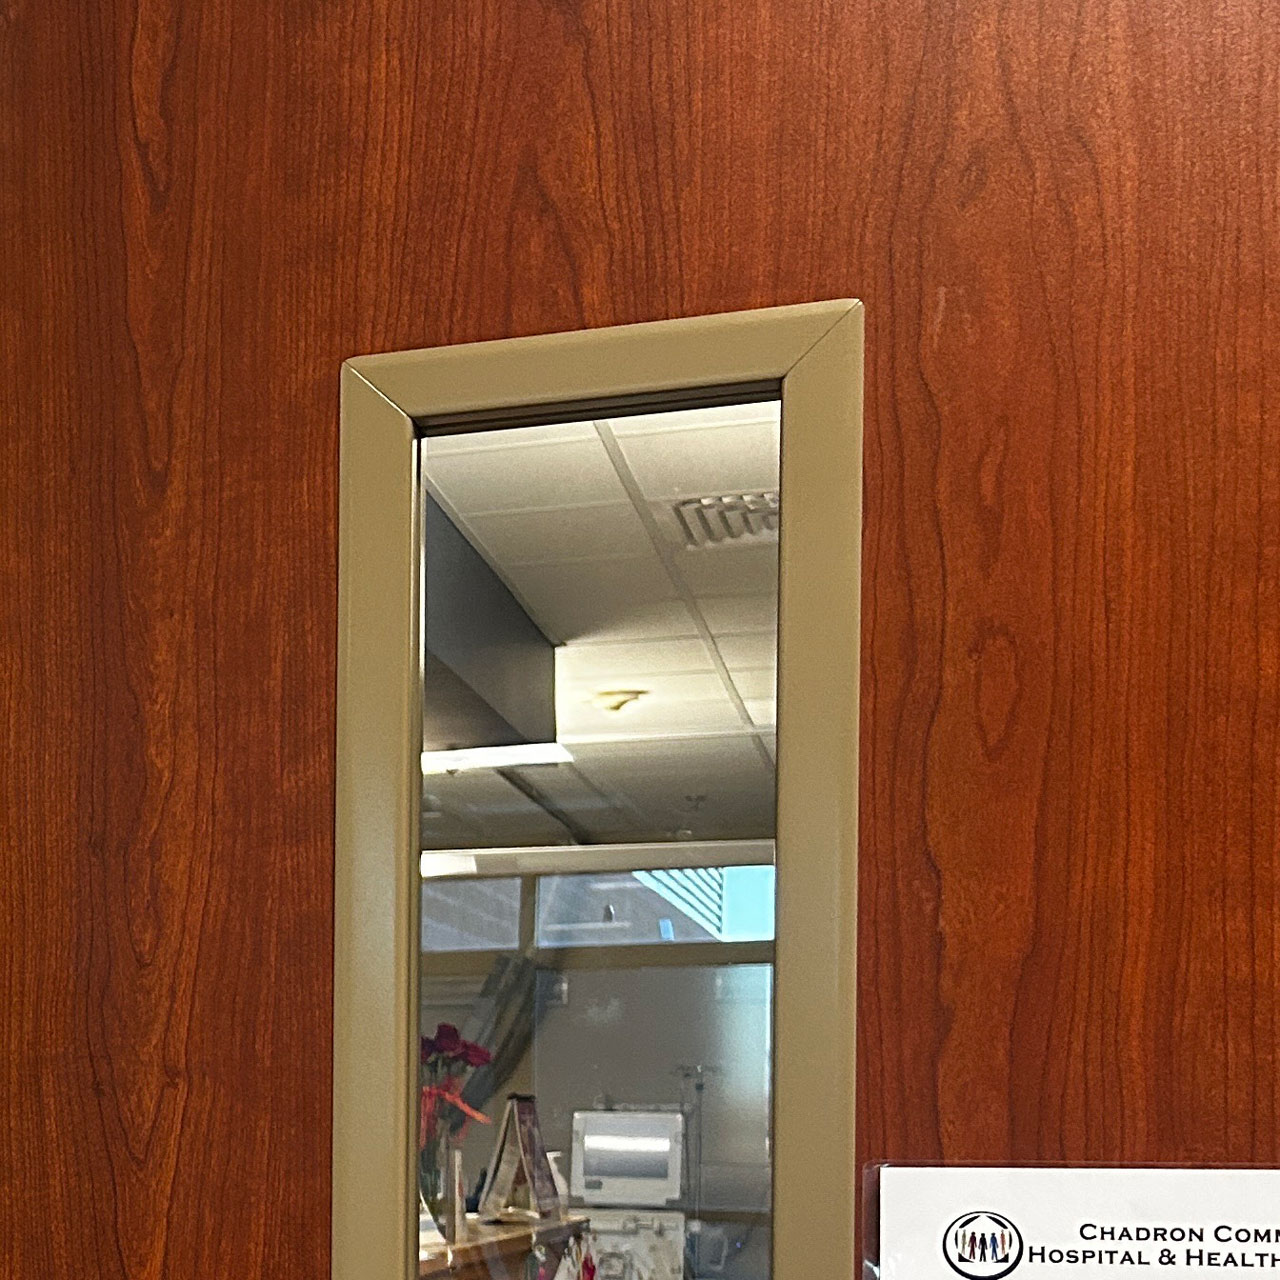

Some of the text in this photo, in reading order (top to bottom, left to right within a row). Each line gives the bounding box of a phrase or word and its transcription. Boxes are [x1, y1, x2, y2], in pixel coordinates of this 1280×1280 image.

[1079, 1223, 1205, 1243] CHADRON
[1028, 1245, 1151, 1266] HOSPITAL
[1157, 1248, 1177, 1266] &
